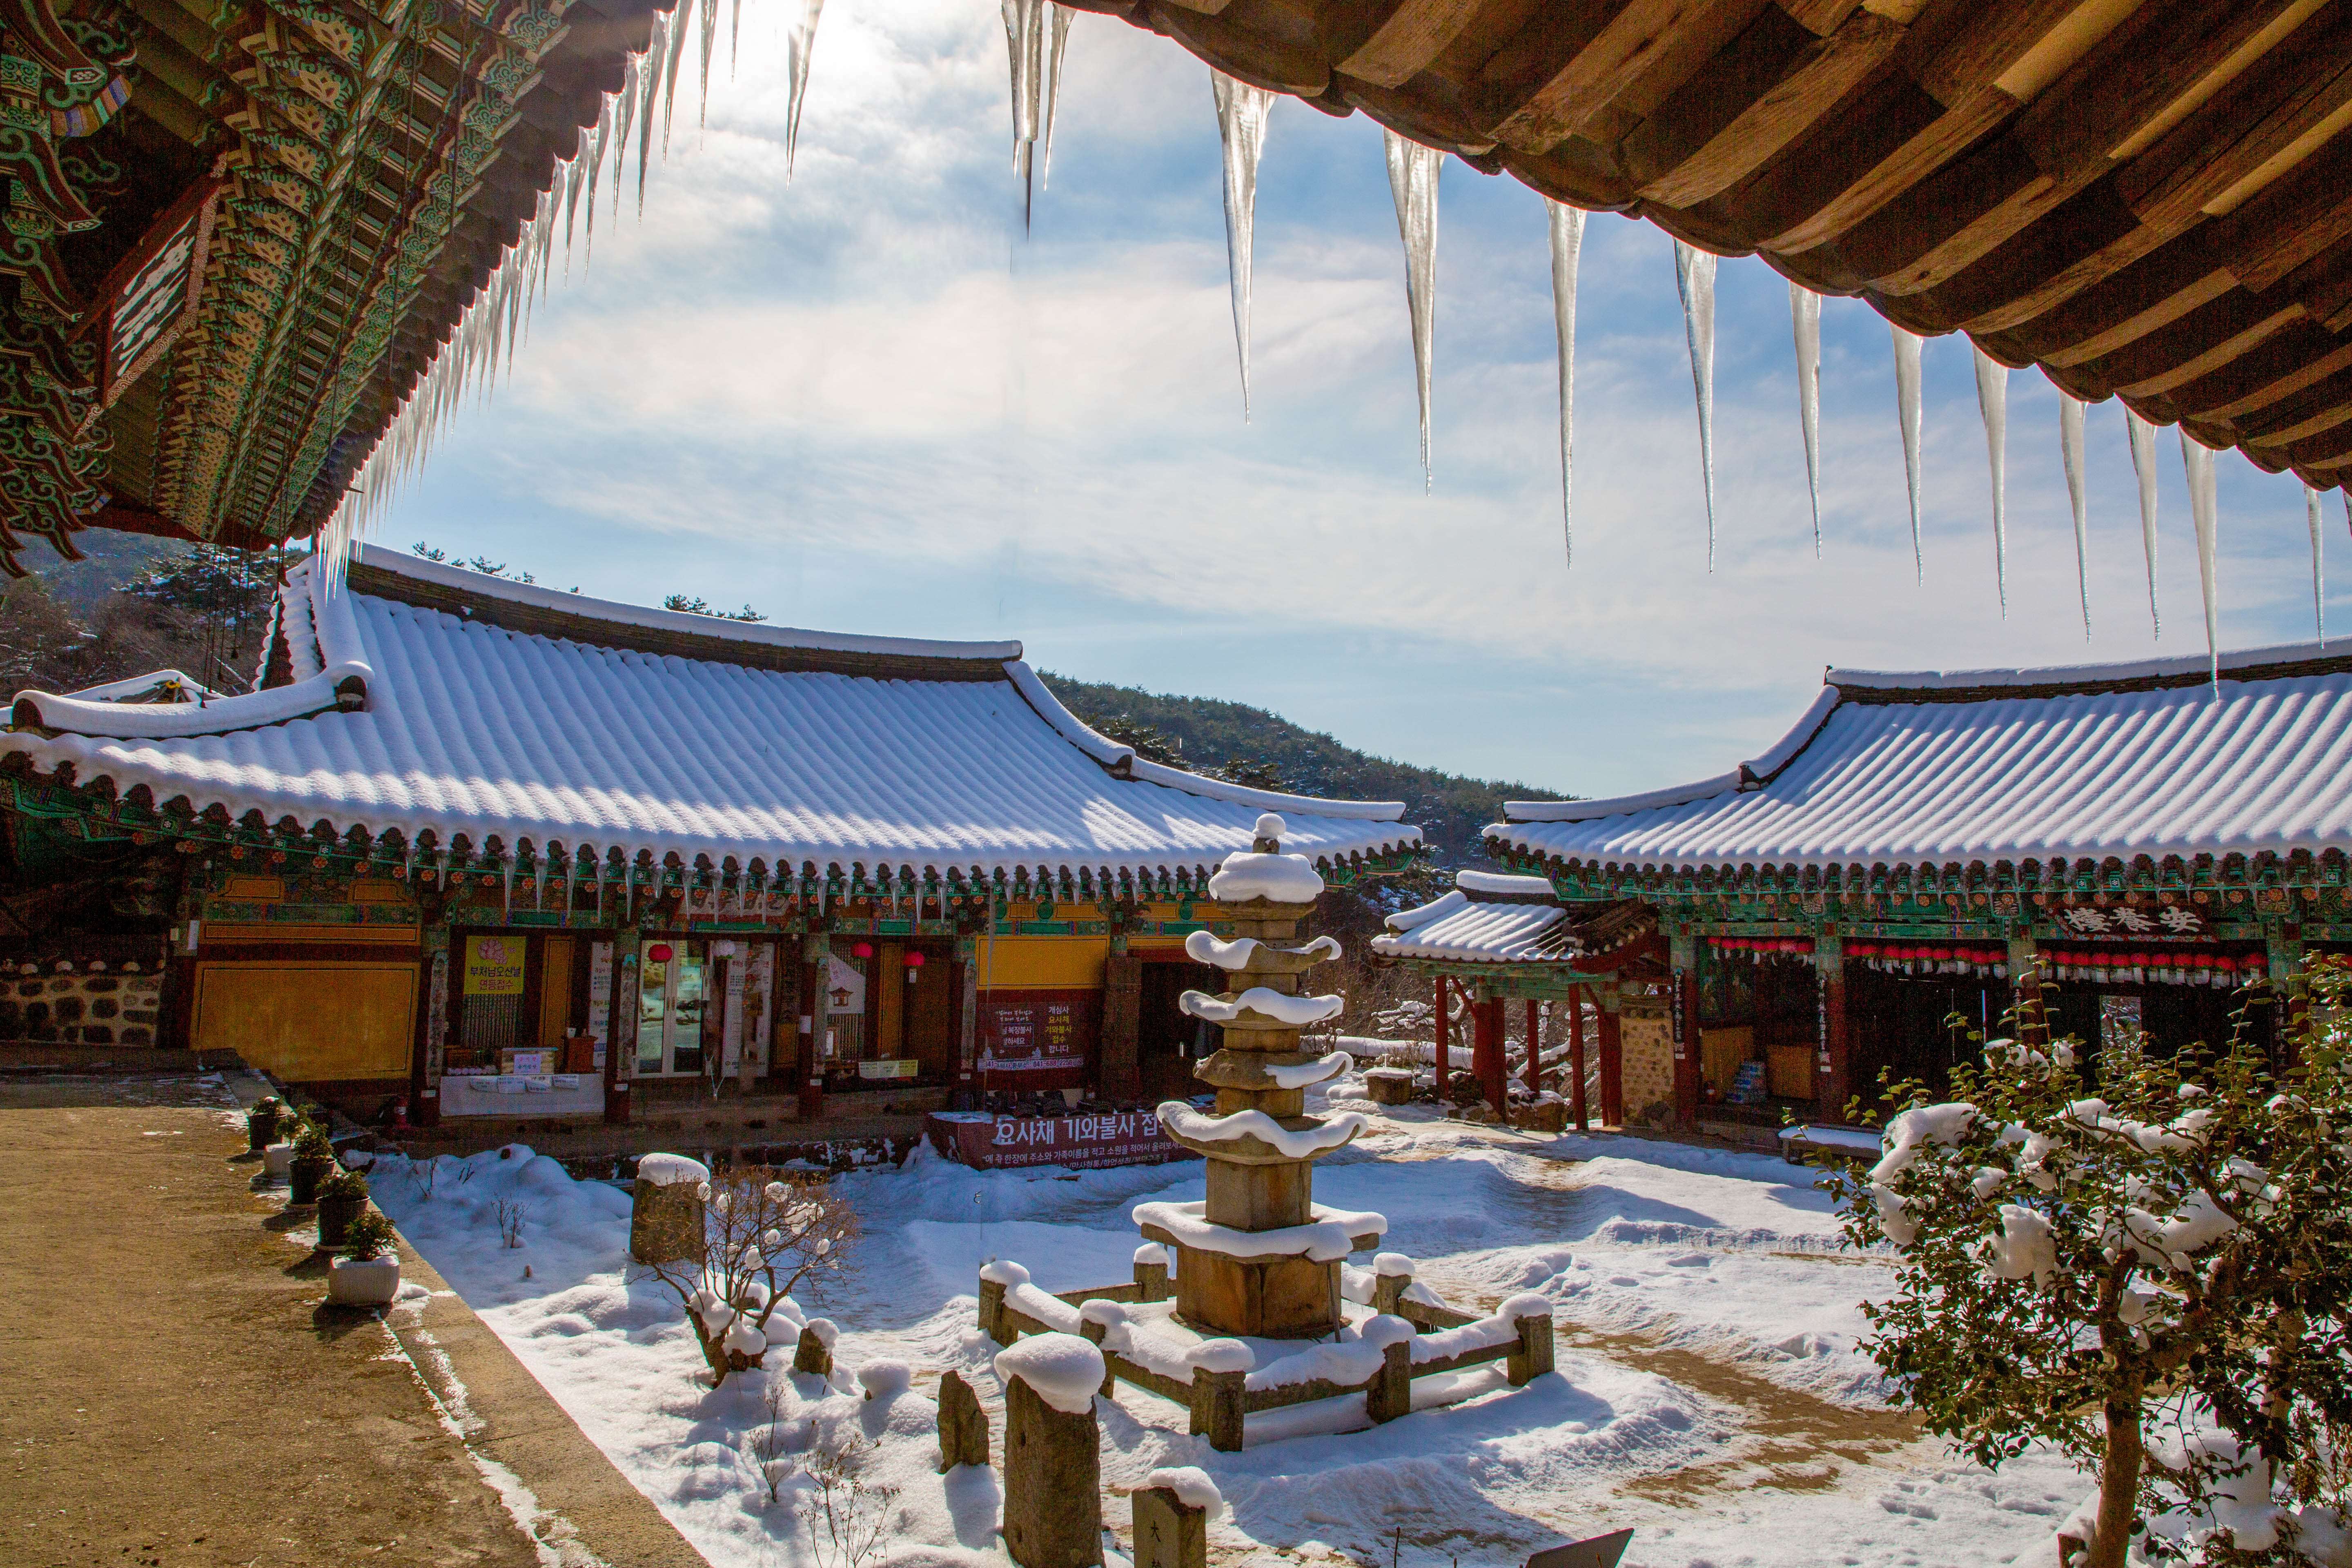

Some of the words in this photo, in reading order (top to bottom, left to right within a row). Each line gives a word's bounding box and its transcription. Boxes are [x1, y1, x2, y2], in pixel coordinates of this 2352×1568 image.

[470, 966, 521, 977] 부처님오신날
[479, 979, 513, 990] 연등접수
[1048, 1016, 1070, 1024] 요사채
[1051, 1035, 1066, 1043] 접수
[1048, 1045, 1069, 1054] 합니다
[997, 1119, 1054, 1146] 요사채
[1062, 1114, 1136, 1142] 기와불사
[1142, 1113, 1164, 1136] 접
[1004, 1153, 1028, 1164] 한장에
[1029, 1152, 1052, 1163] 주소와
[1054, 1148, 1089, 1160] 가족이름을
[1091, 1147, 1105, 1156] 적고
[1107, 1145, 1129, 1155] 소원을
[1130, 1143, 1151, 1153] 적어서
[1163, 1153, 1169, 1162] 등
